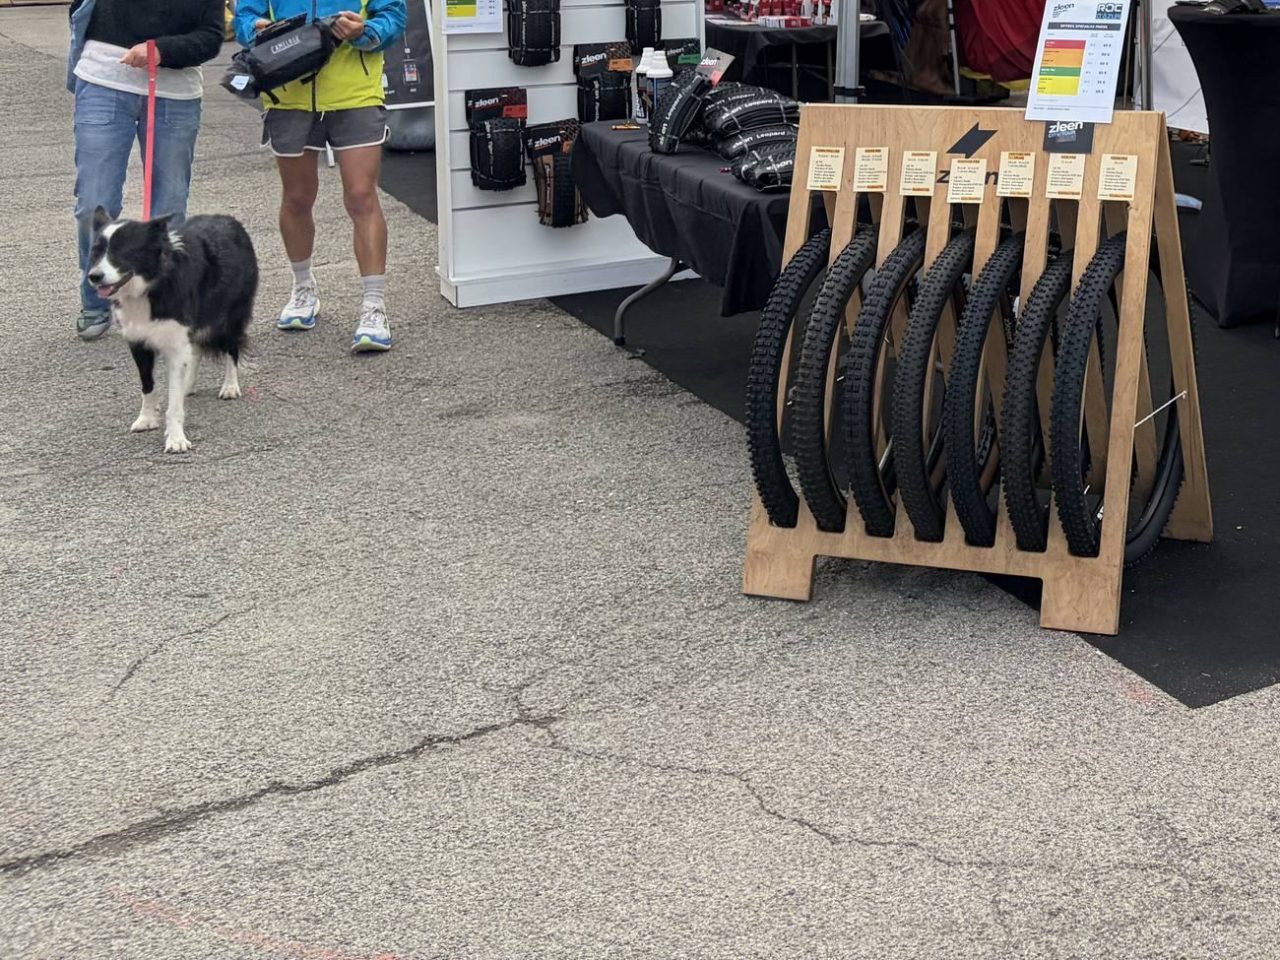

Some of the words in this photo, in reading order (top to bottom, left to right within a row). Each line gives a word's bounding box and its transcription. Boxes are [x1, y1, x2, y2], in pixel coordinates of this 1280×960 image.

[581, 52, 607, 65] zleen
[474, 96, 499, 109] zleen
[1048, 121, 1084, 134] zleen
[534, 134, 561, 148] zleen
